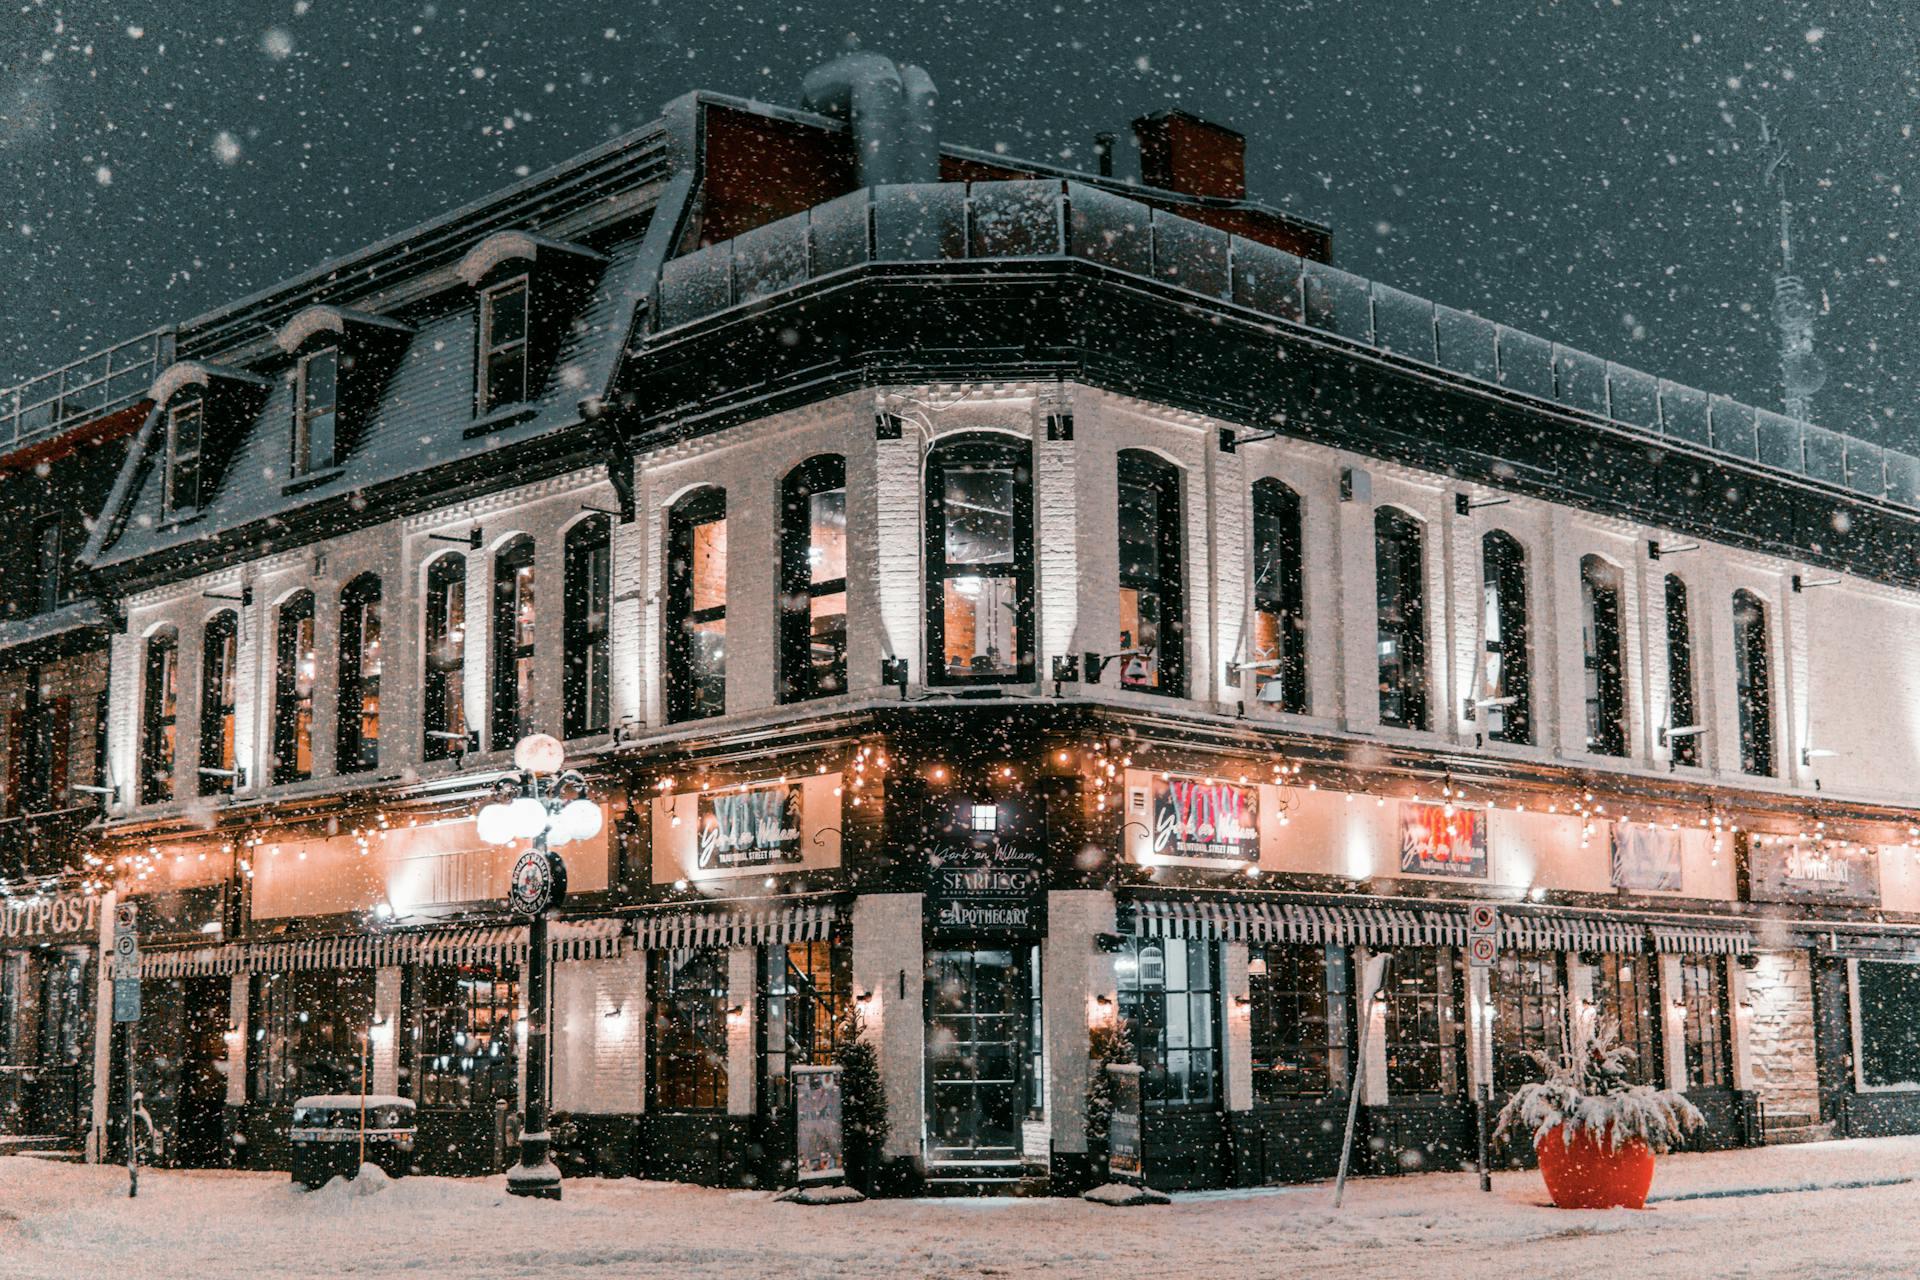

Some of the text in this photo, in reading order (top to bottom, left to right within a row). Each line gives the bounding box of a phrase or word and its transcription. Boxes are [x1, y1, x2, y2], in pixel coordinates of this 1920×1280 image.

[930, 843, 970, 872] York
[993, 841, 1037, 862] William
[943, 872, 1026, 890] STARLIG
[940, 900, 1030, 925] APOTHECARY
